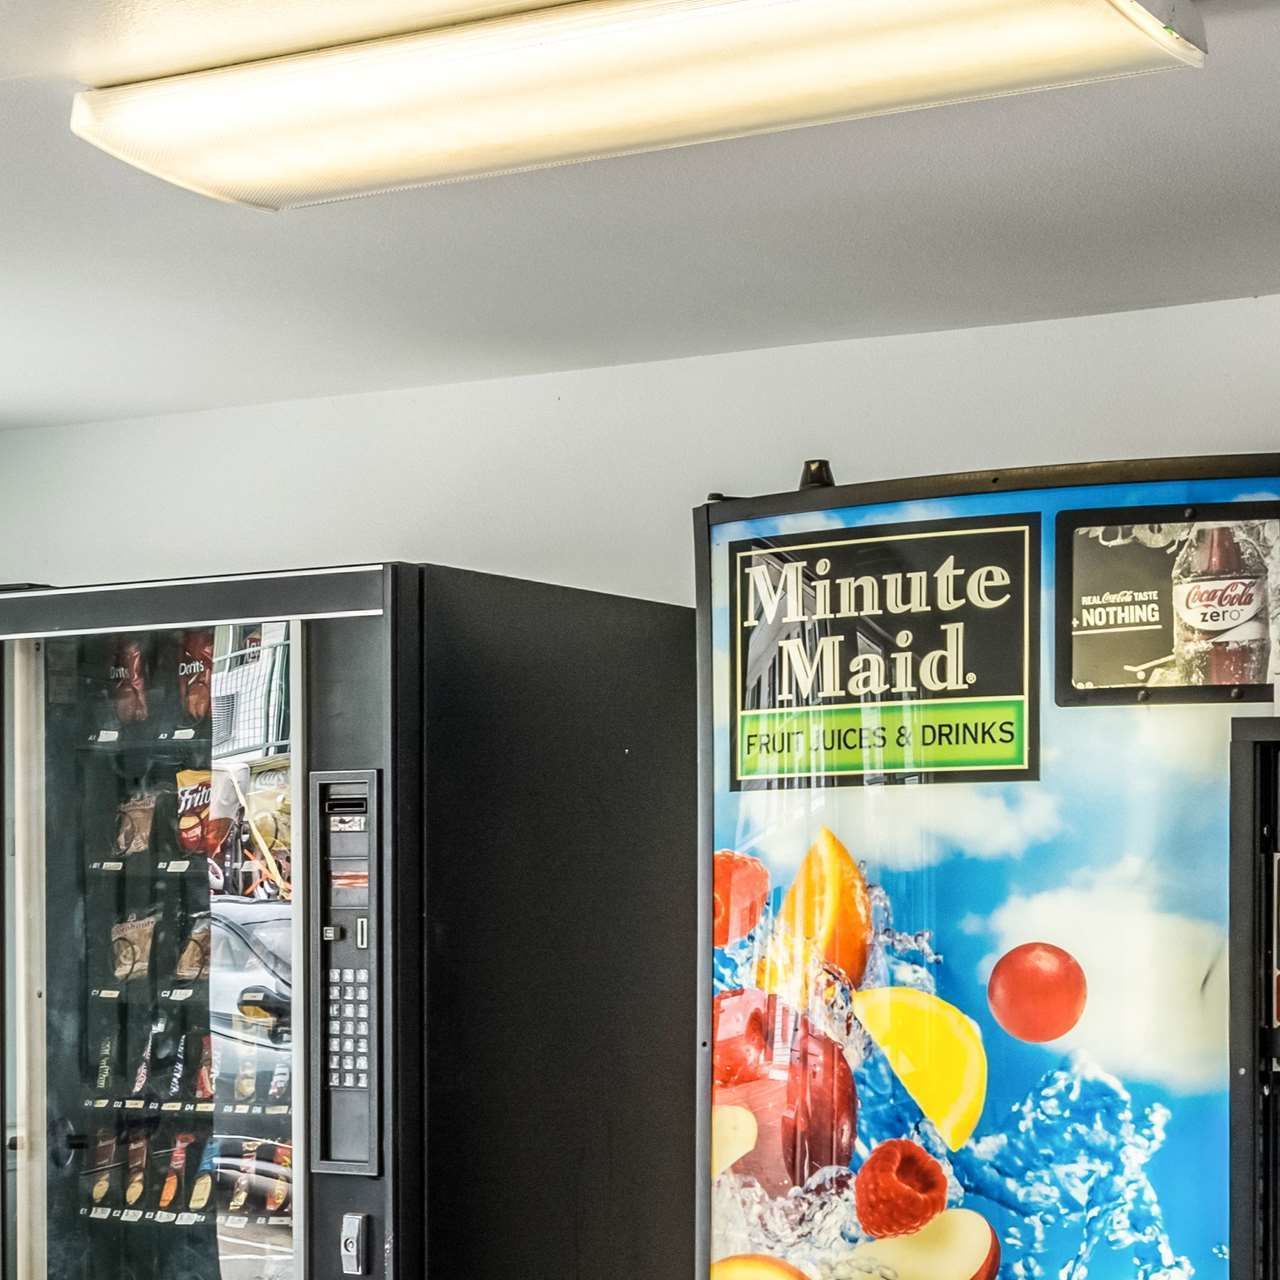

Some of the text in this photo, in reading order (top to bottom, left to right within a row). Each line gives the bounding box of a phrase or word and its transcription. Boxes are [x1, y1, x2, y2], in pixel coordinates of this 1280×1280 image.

[743, 554, 1011, 627] Minute
[1081, 595, 1102, 606] REAL
[1133, 590, 1159, 602] TASTE
[1082, 603, 1160, 627] NOTHING
[1200, 610, 1241, 623] zero
[746, 721, 1016, 756] FRUIT JUICES & DRINKS
